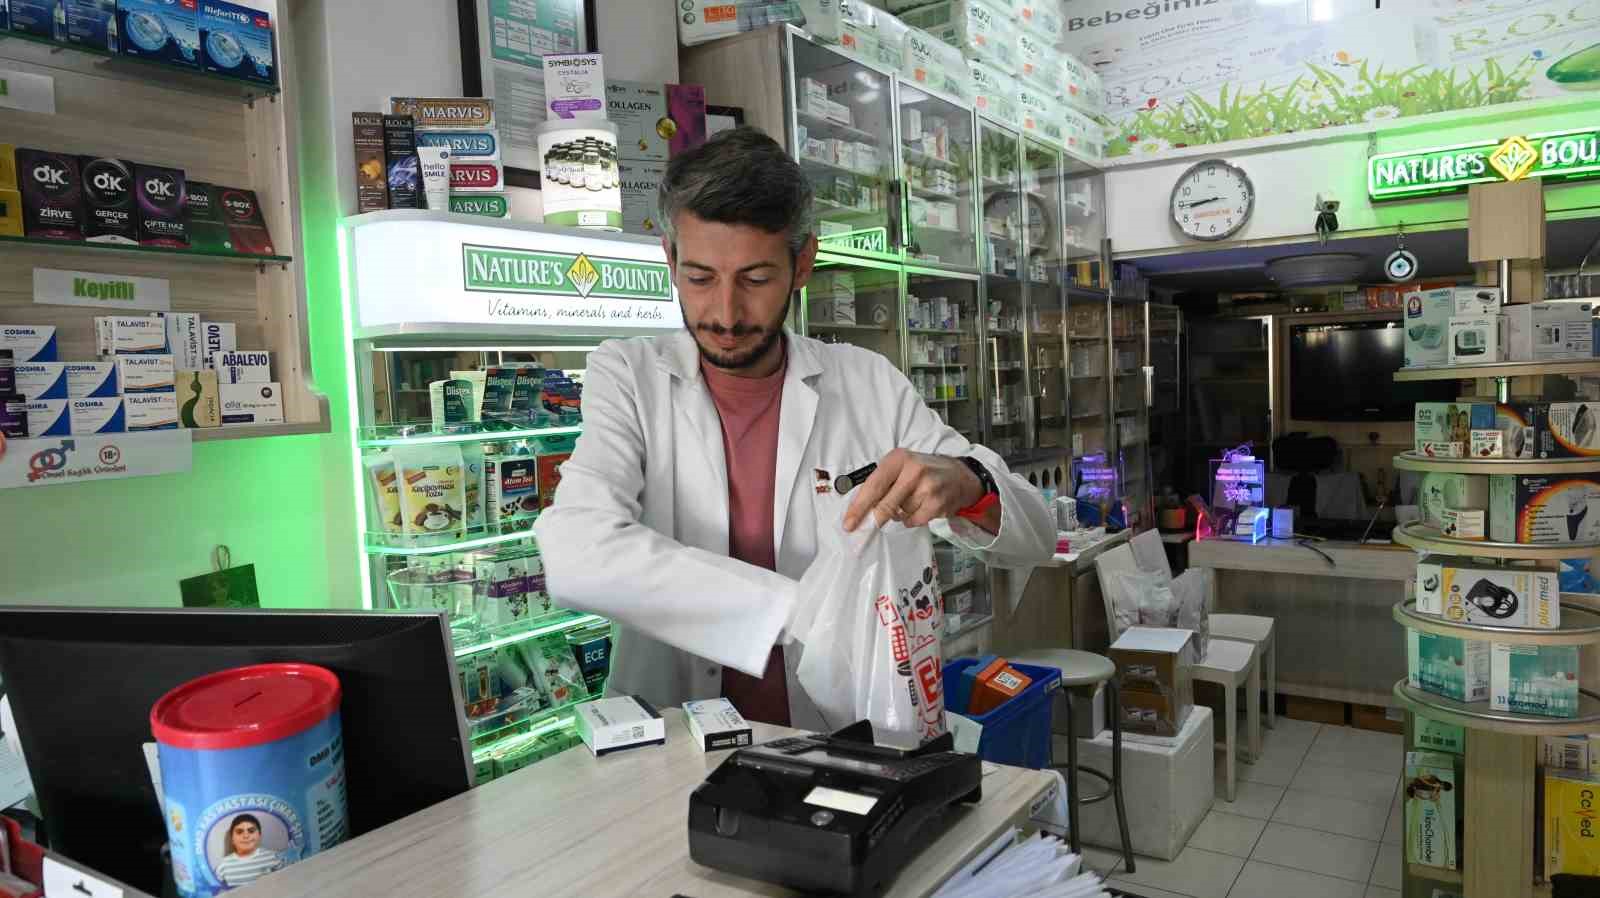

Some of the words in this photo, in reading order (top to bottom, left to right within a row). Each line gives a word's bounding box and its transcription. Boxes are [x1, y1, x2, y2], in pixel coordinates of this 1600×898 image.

[422, 106, 483, 120] MARVIS
[609, 101, 652, 111] OLLAGEN
[449, 170, 492, 182] ARVIS
[454, 200, 499, 213] ARVIS
[470, 252, 565, 286] NATURE'S
[601, 264, 667, 292] BOUNTY
[556, 304, 607, 320] minerals
[609, 305, 632, 319] and
[222, 353, 268, 367] ABALEVO
[584, 648, 605, 664] ECE
